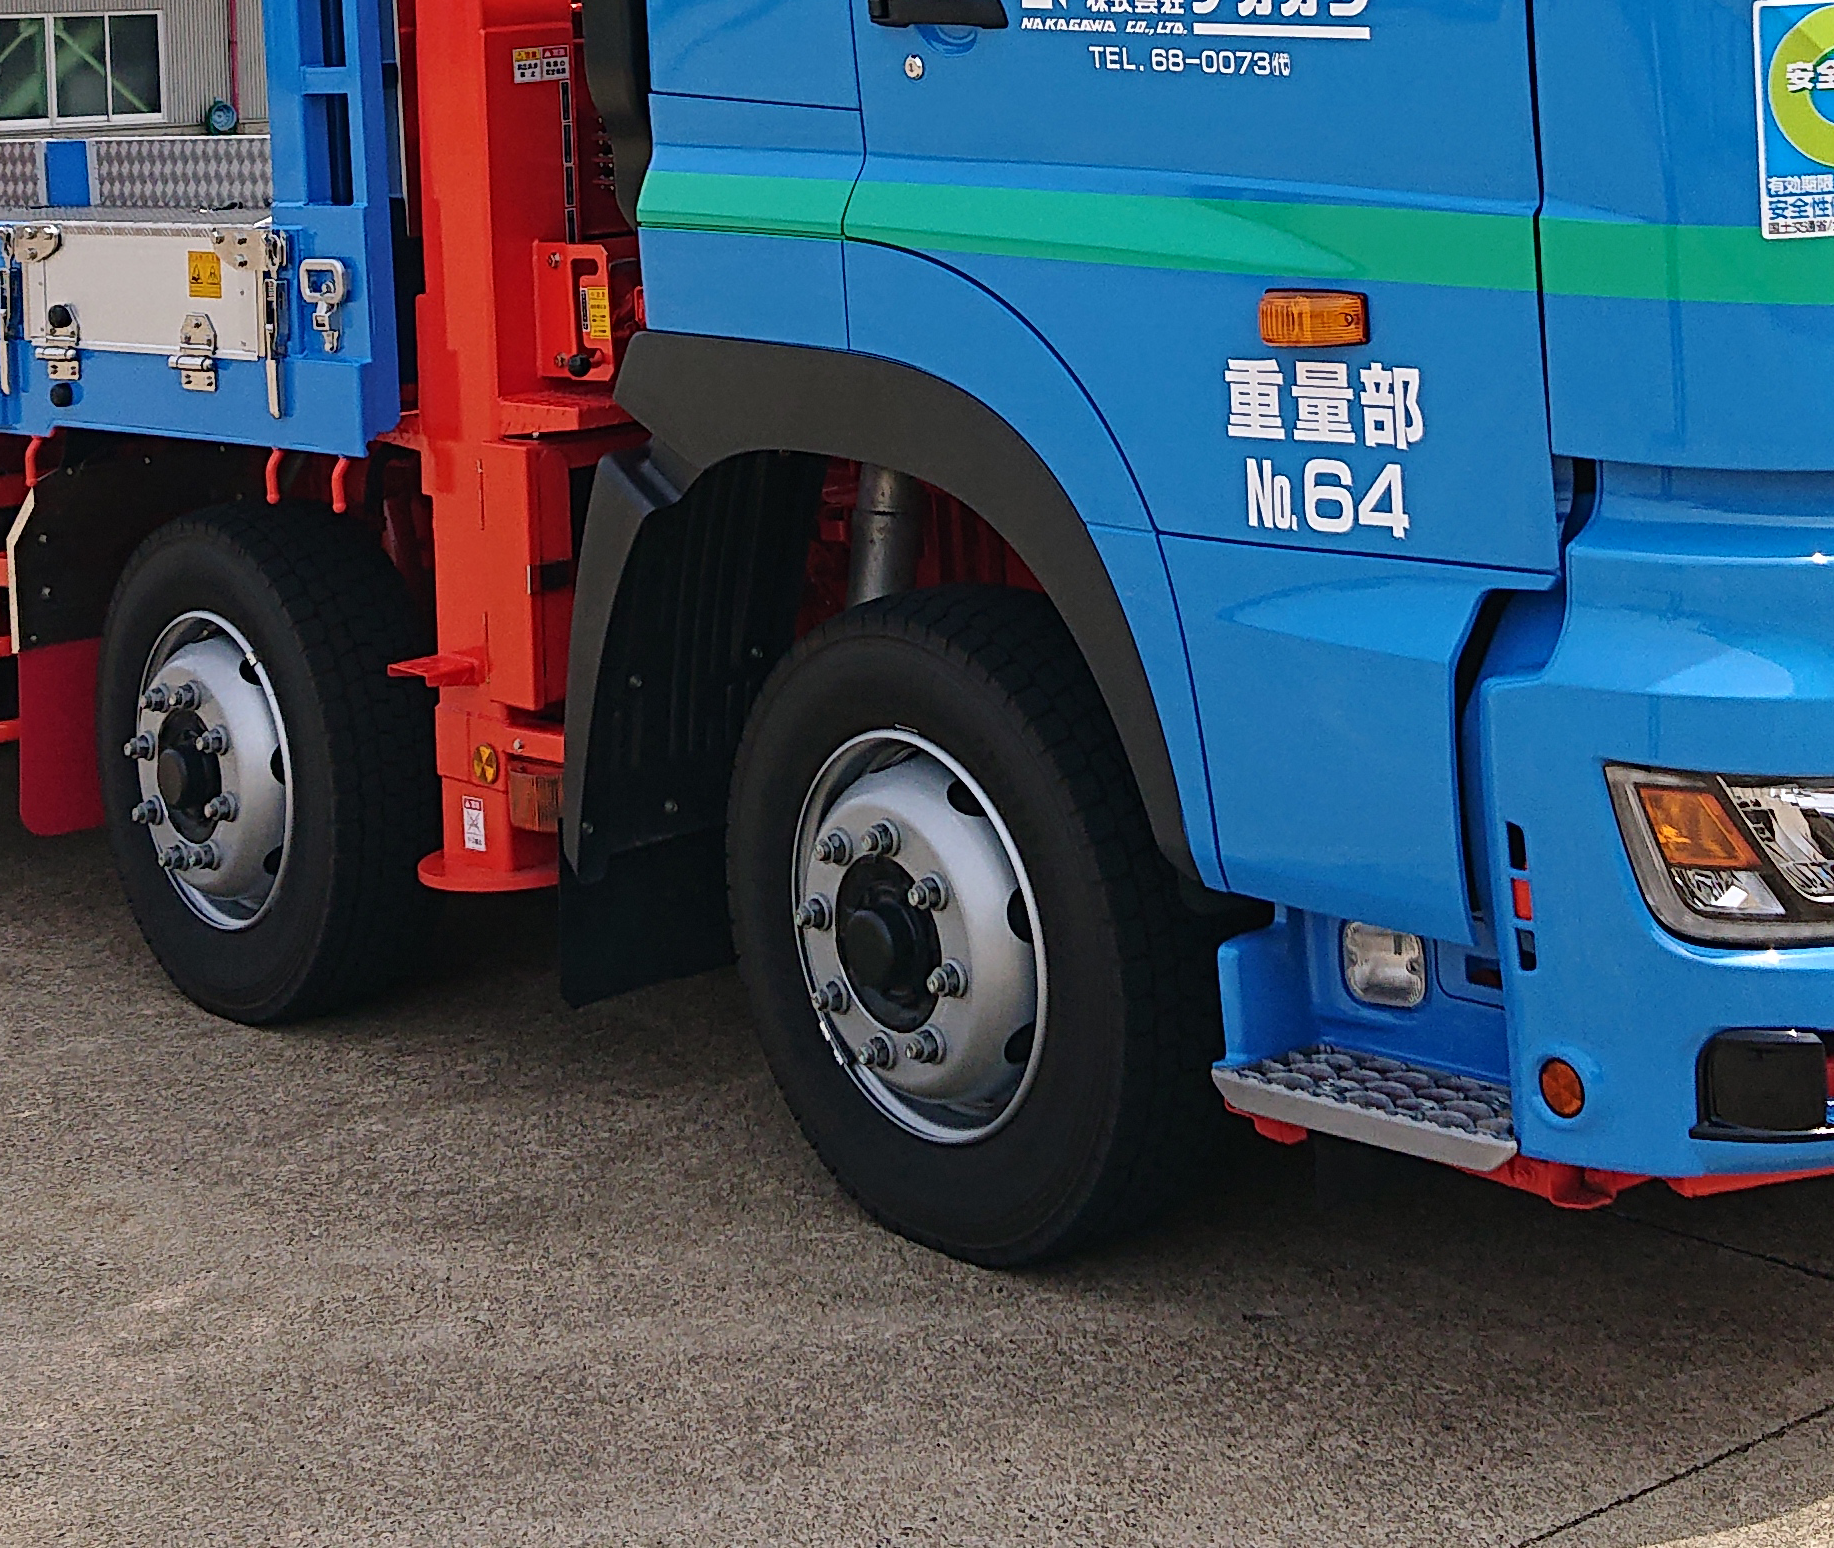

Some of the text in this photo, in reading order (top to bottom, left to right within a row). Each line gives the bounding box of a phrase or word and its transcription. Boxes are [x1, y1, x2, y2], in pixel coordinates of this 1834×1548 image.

[1021, 17, 1116, 33] NAKAGAWA
[1088, 45, 1145, 71] TEL.
[1224, 358, 1425, 451] 重量部
